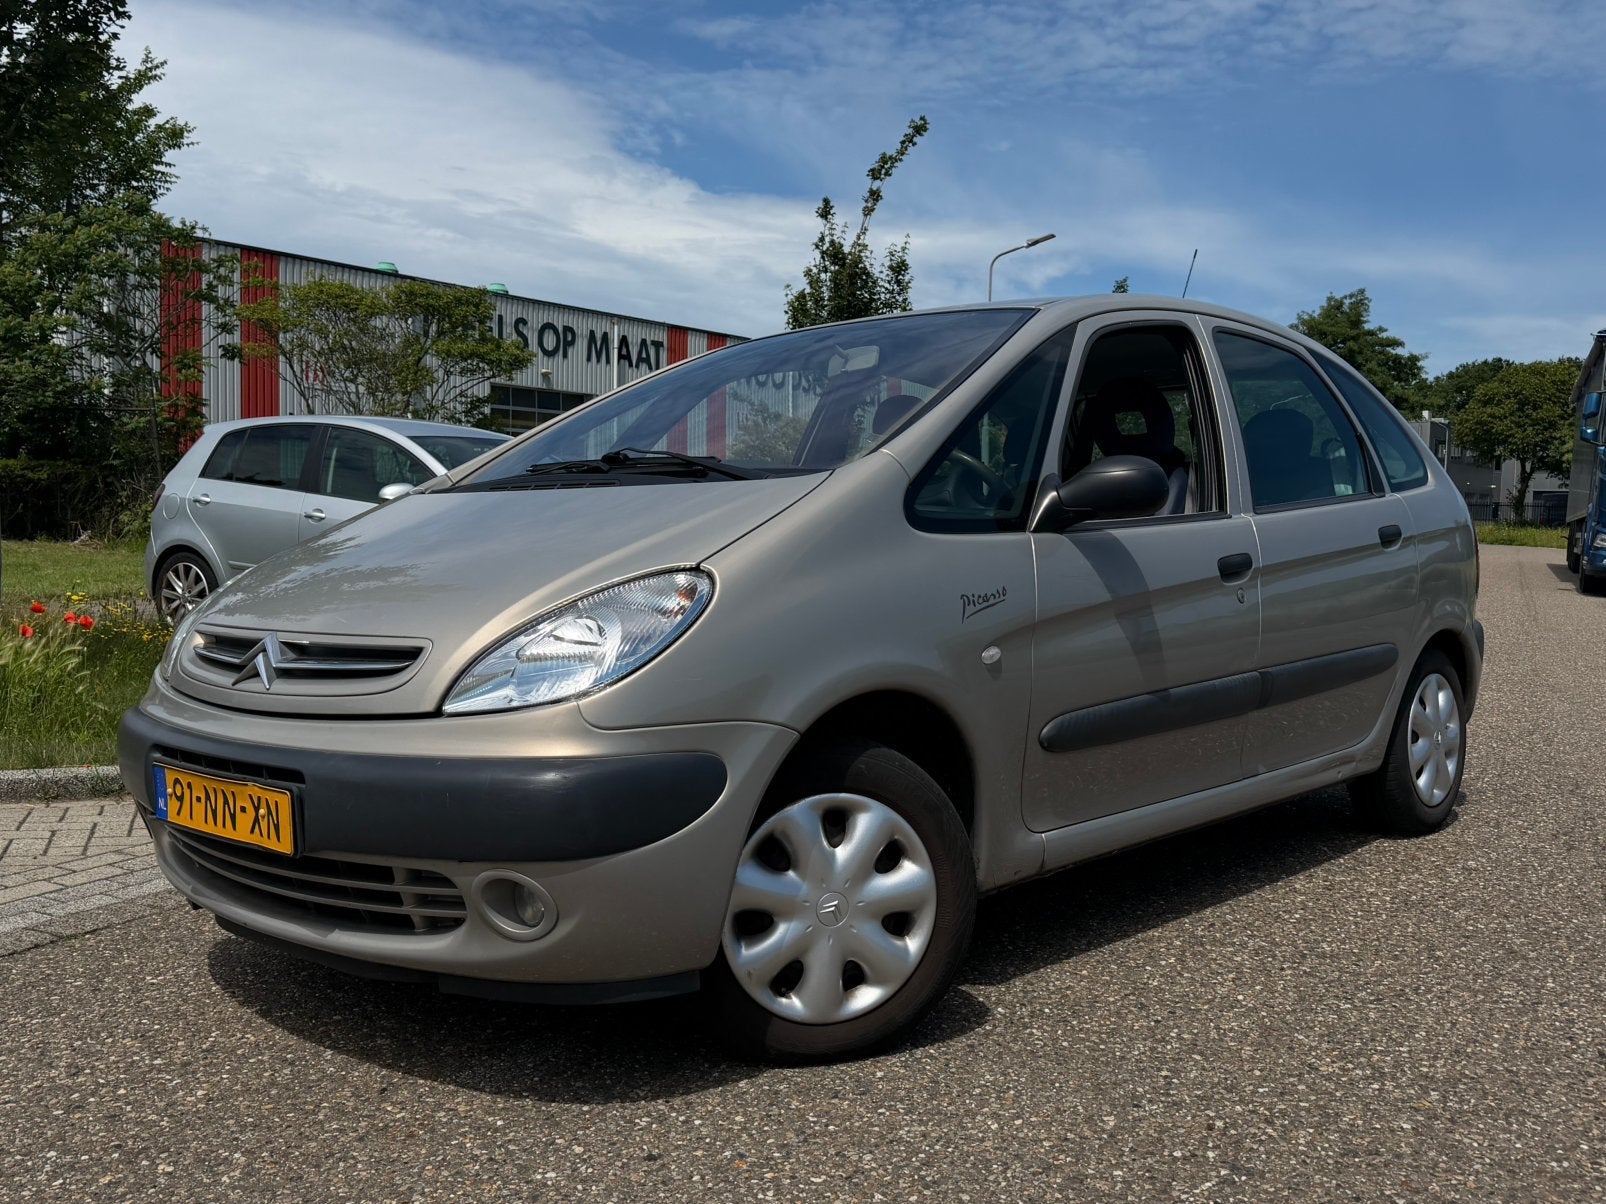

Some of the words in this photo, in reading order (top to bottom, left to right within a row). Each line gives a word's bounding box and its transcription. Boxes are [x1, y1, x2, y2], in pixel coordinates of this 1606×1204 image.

[538, 322, 576, 359] OP
[586, 329, 664, 371] MAAT
[960, 586, 1007, 624] Picasso
[158, 797, 167, 811] NL
[172, 777, 281, 843] 91-NN-XN
